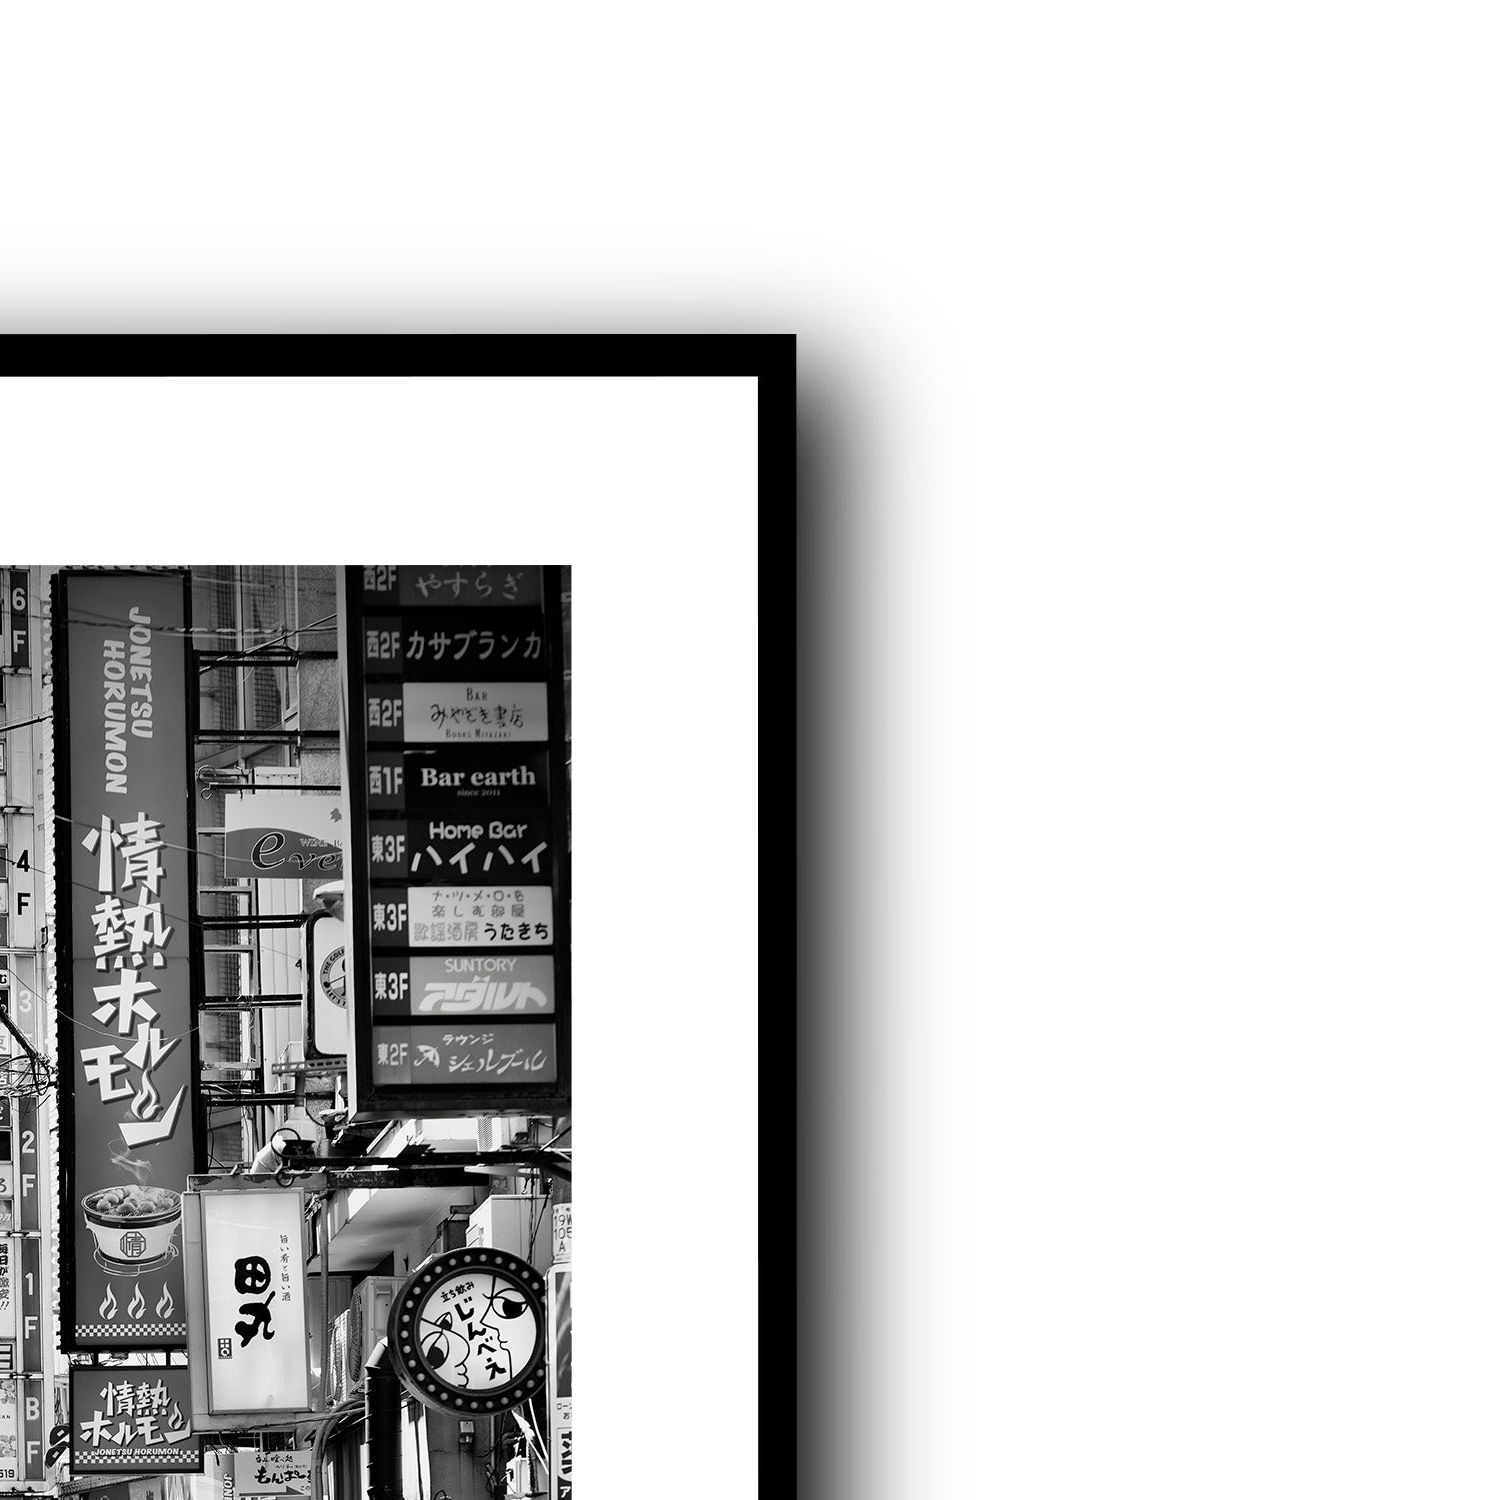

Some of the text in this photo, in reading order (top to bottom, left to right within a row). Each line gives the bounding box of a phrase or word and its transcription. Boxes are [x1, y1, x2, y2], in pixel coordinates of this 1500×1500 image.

[415, 570, 525, 600] やすらぎ
[11, 587, 27, 654] 6F
[366, 629, 544, 661] 西2F カサブランカ
[128, 605, 153, 739] JONETSU
[102, 638, 129, 794] HORUMON
[368, 697, 403, 728] 西2F
[368, 763, 538, 796] 西1F Bar earth
[428, 820, 528, 842] Home Bar
[371, 834, 548, 875] 東3F ハイハイ
[16, 849, 32, 917] 4F
[372, 902, 526, 932] 東3F 楽しむ部屋
[483, 922, 549, 942] うたきち
[81, 810, 188, 1149] 情熱ホルモン
[443, 957, 518, 973] SUNTORY
[374, 971, 548, 1012] 東3F アダルト
[442, 1032, 495, 1046] ラウンジ
[376, 1042, 548, 1075] 東2F シェルブール
[21, 1130, 36, 1197] 2F
[24, 1271, 39, 1340] 1F
[233, 1254, 276, 1349] 田丸
[440, 1280, 475, 1303] 立ち飲み
[453, 1295, 507, 1382] じんべえ
[99, 1379, 172, 1417] 情熱
[79, 1409, 192, 1448] ホルモン
[94, 1447, 181, 1457] JONETSU HORUMON
